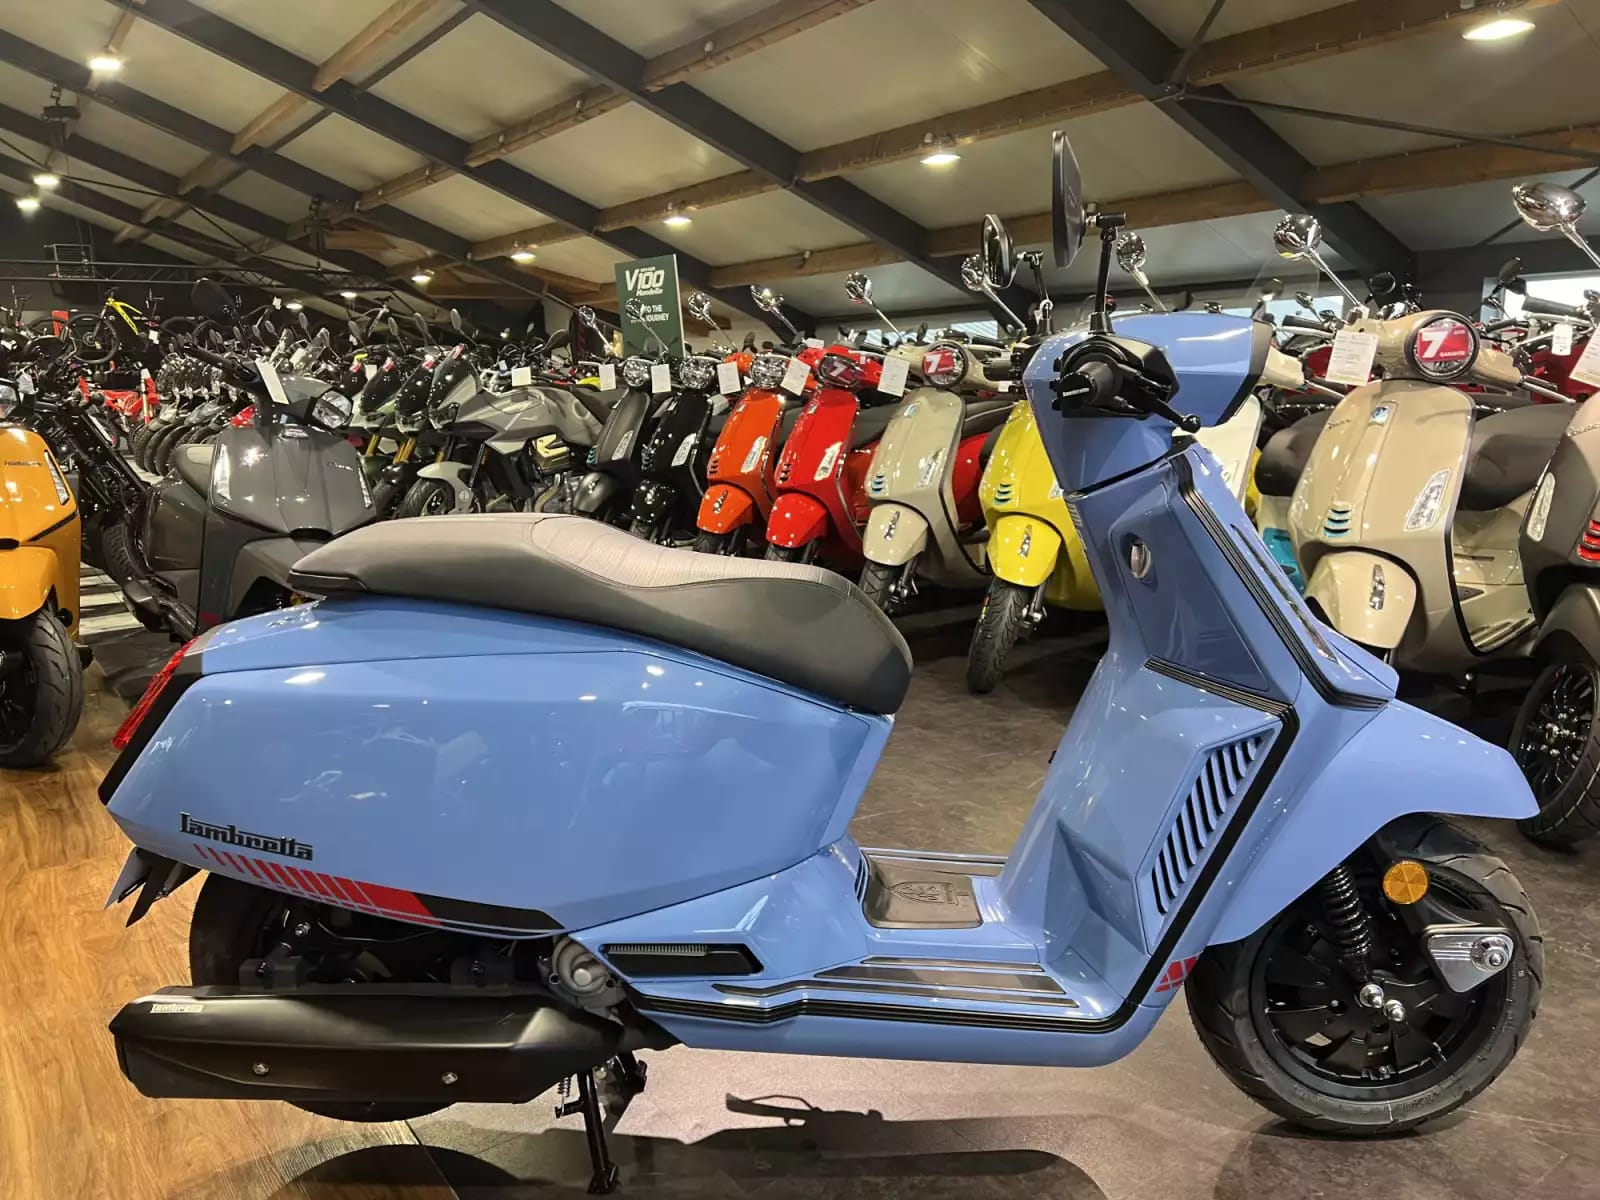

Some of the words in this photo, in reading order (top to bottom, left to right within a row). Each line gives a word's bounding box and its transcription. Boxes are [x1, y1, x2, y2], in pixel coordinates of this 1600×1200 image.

[625, 268, 665, 291] V100
[652, 304, 663, 313] THE
[1420, 330, 1449, 358] 7
[925, 353, 942, 374] 7
